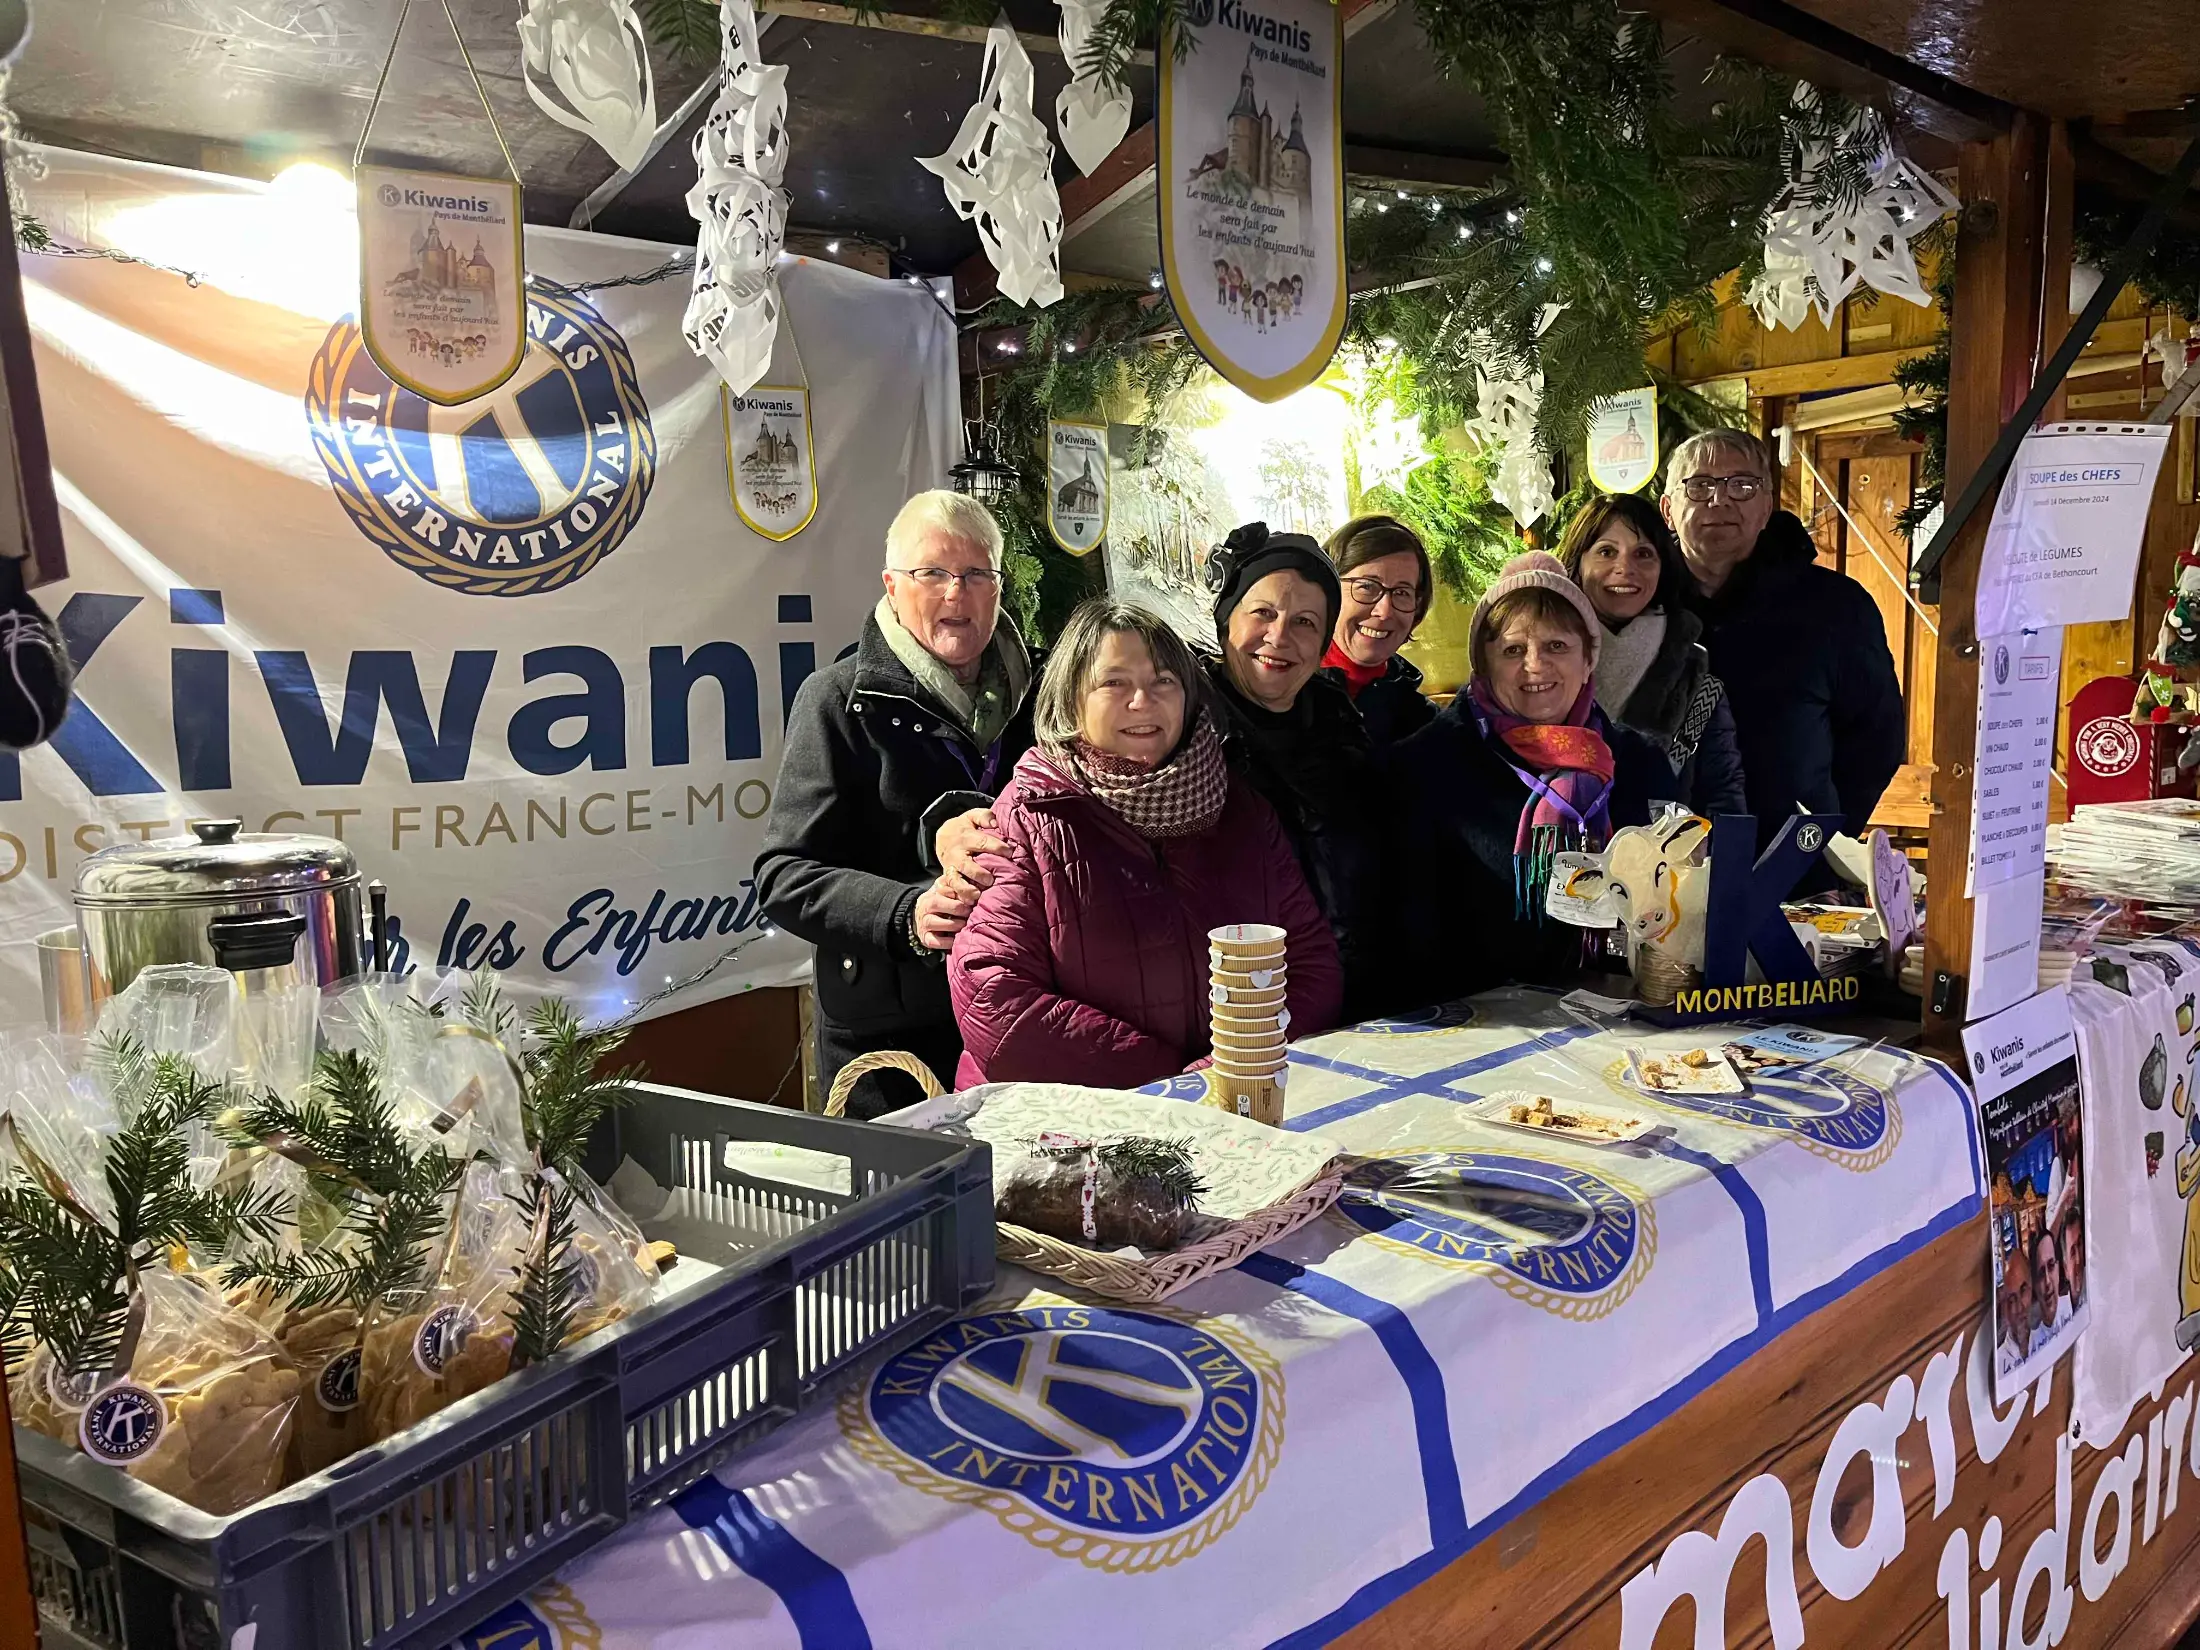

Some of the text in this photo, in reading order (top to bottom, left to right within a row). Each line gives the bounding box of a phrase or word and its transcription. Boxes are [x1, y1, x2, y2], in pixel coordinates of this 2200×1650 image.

[1218, 0, 1311, 52] Kiwanis
[1250, 42, 1268, 61] Pays
[1269, 48, 1280, 62] de
[404, 189, 489, 213] Kiwanis
[434, 211, 451, 220] Pays
[1186, 186, 1286, 218] Le monde de demain
[1220, 214, 1278, 235] sera fait par
[1198, 225, 1316, 258] les enfants d'aujourd'hui
[747, 399, 793, 411] Kiwanis
[1065, 434, 1096, 446] Kiwanis
[346, 387, 626, 565] INTERNATIONAL
[2029, 469, 2121, 485] SOUPE des CHEFS
[0, 586, 860, 801] Kiwani
[436, 897, 526, 978] les
[1676, 976, 1859, 1014] MONTBELIARD
[1991, 1036, 2024, 1064] Kiwanis
[880, 1309, 1090, 1396] KIWANIS
[108, 1393, 154, 1415] KIWANIS
[91, 1409, 155, 1453] INTERNATIONAL
[929, 1336, 1250, 1524] INTERNATIONAL
